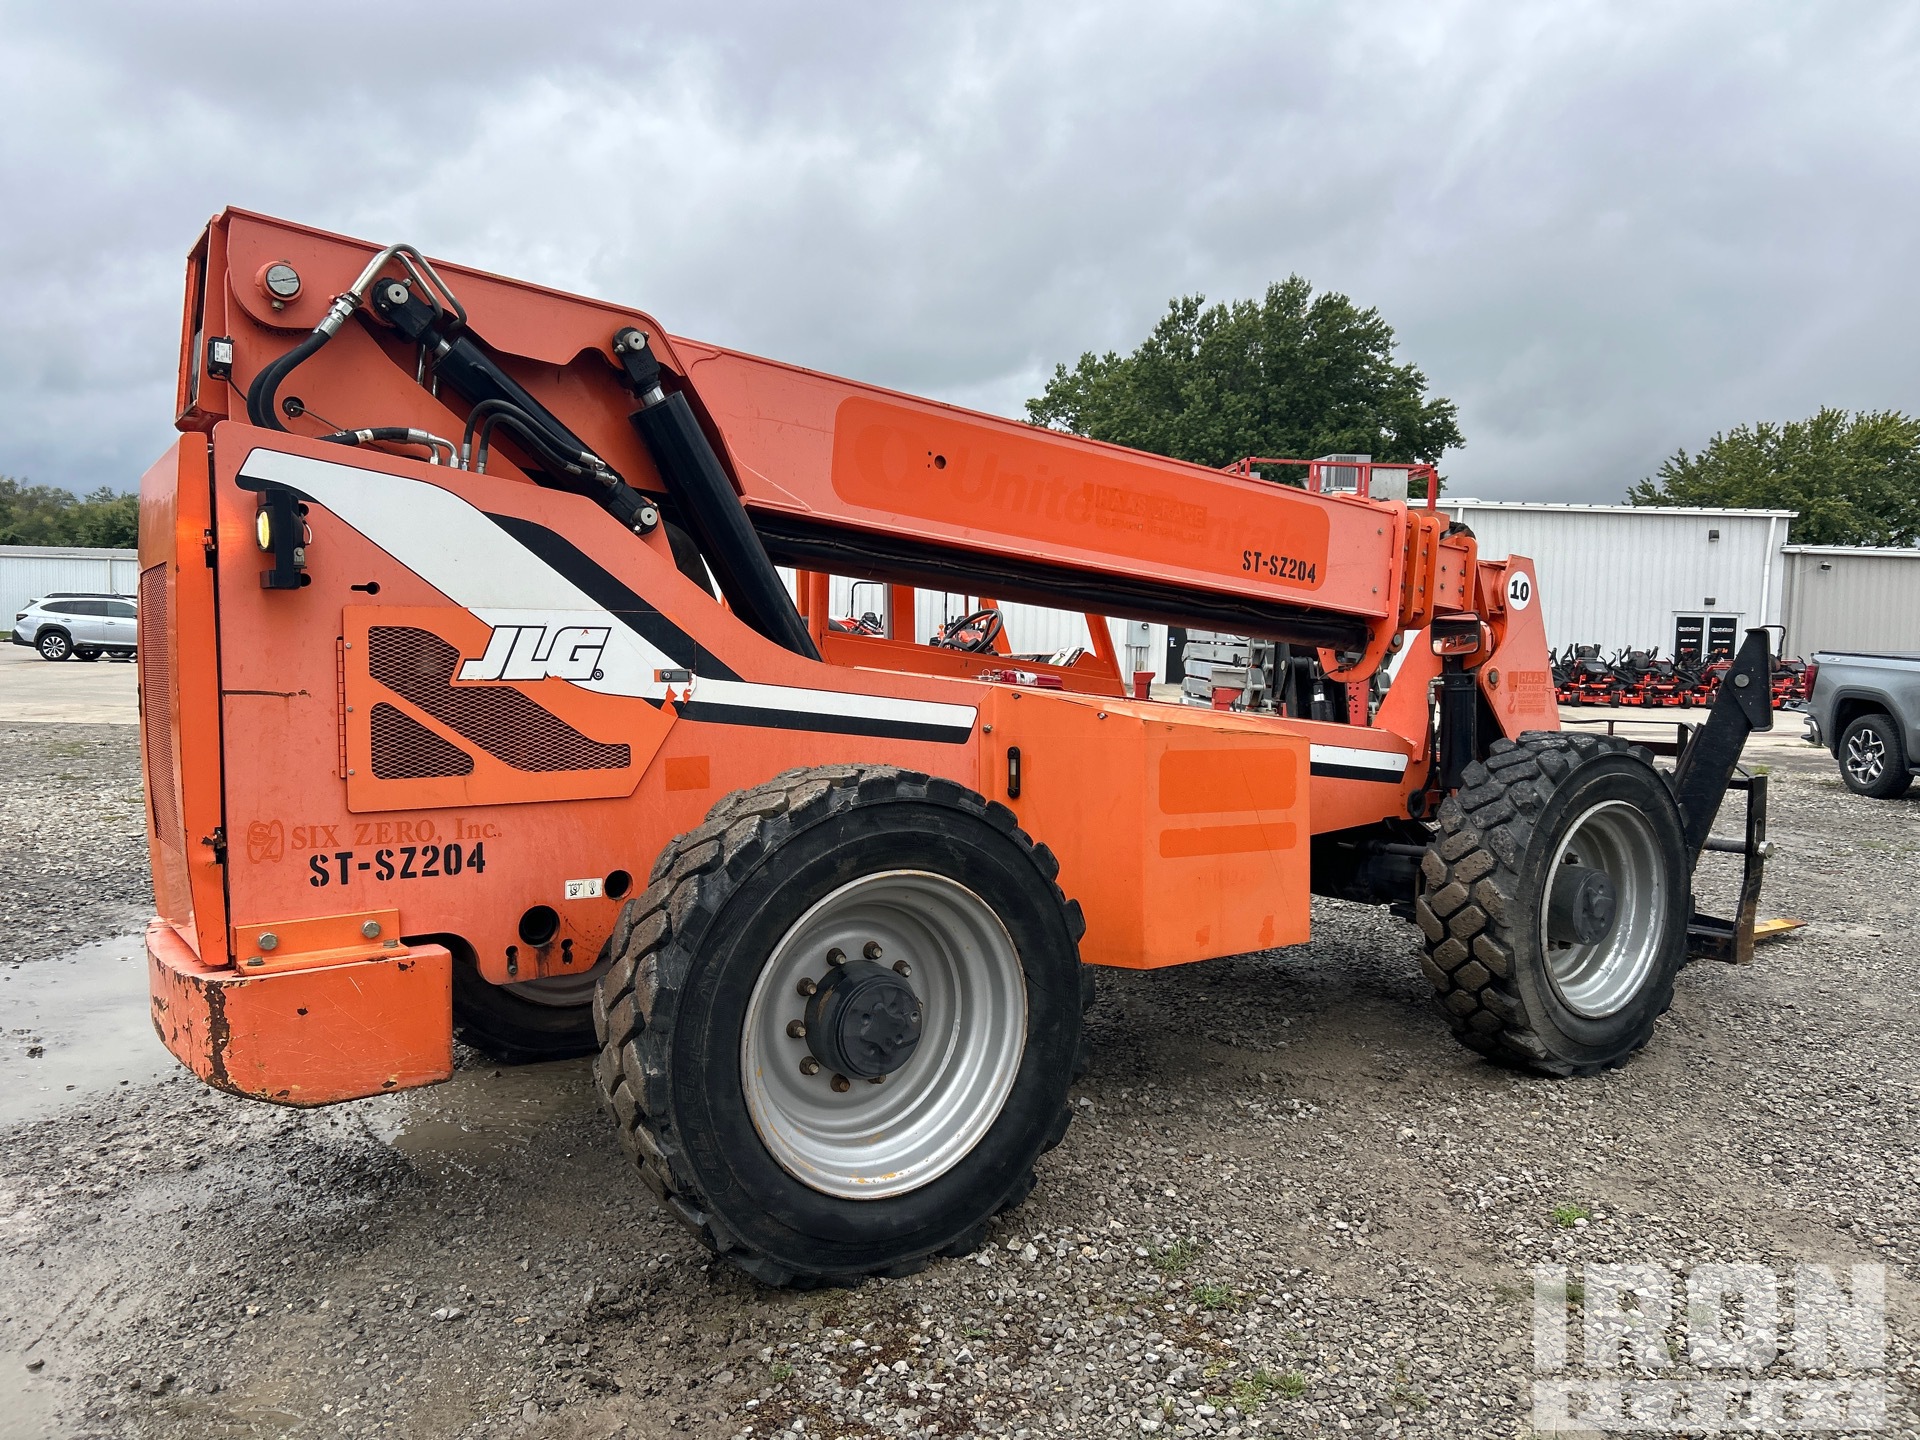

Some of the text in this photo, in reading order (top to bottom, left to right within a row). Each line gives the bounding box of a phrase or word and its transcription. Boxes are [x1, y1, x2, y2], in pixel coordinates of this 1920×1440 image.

[1242, 550, 1317, 584] ST-SZ204
[1510, 580, 1530, 602] 10
[456, 625, 612, 681] JLG
[1520, 673, 1545, 683] HAAS
[291, 817, 503, 851] SIX ZERO, Inc.
[309, 841, 486, 888] ST-SZ204
